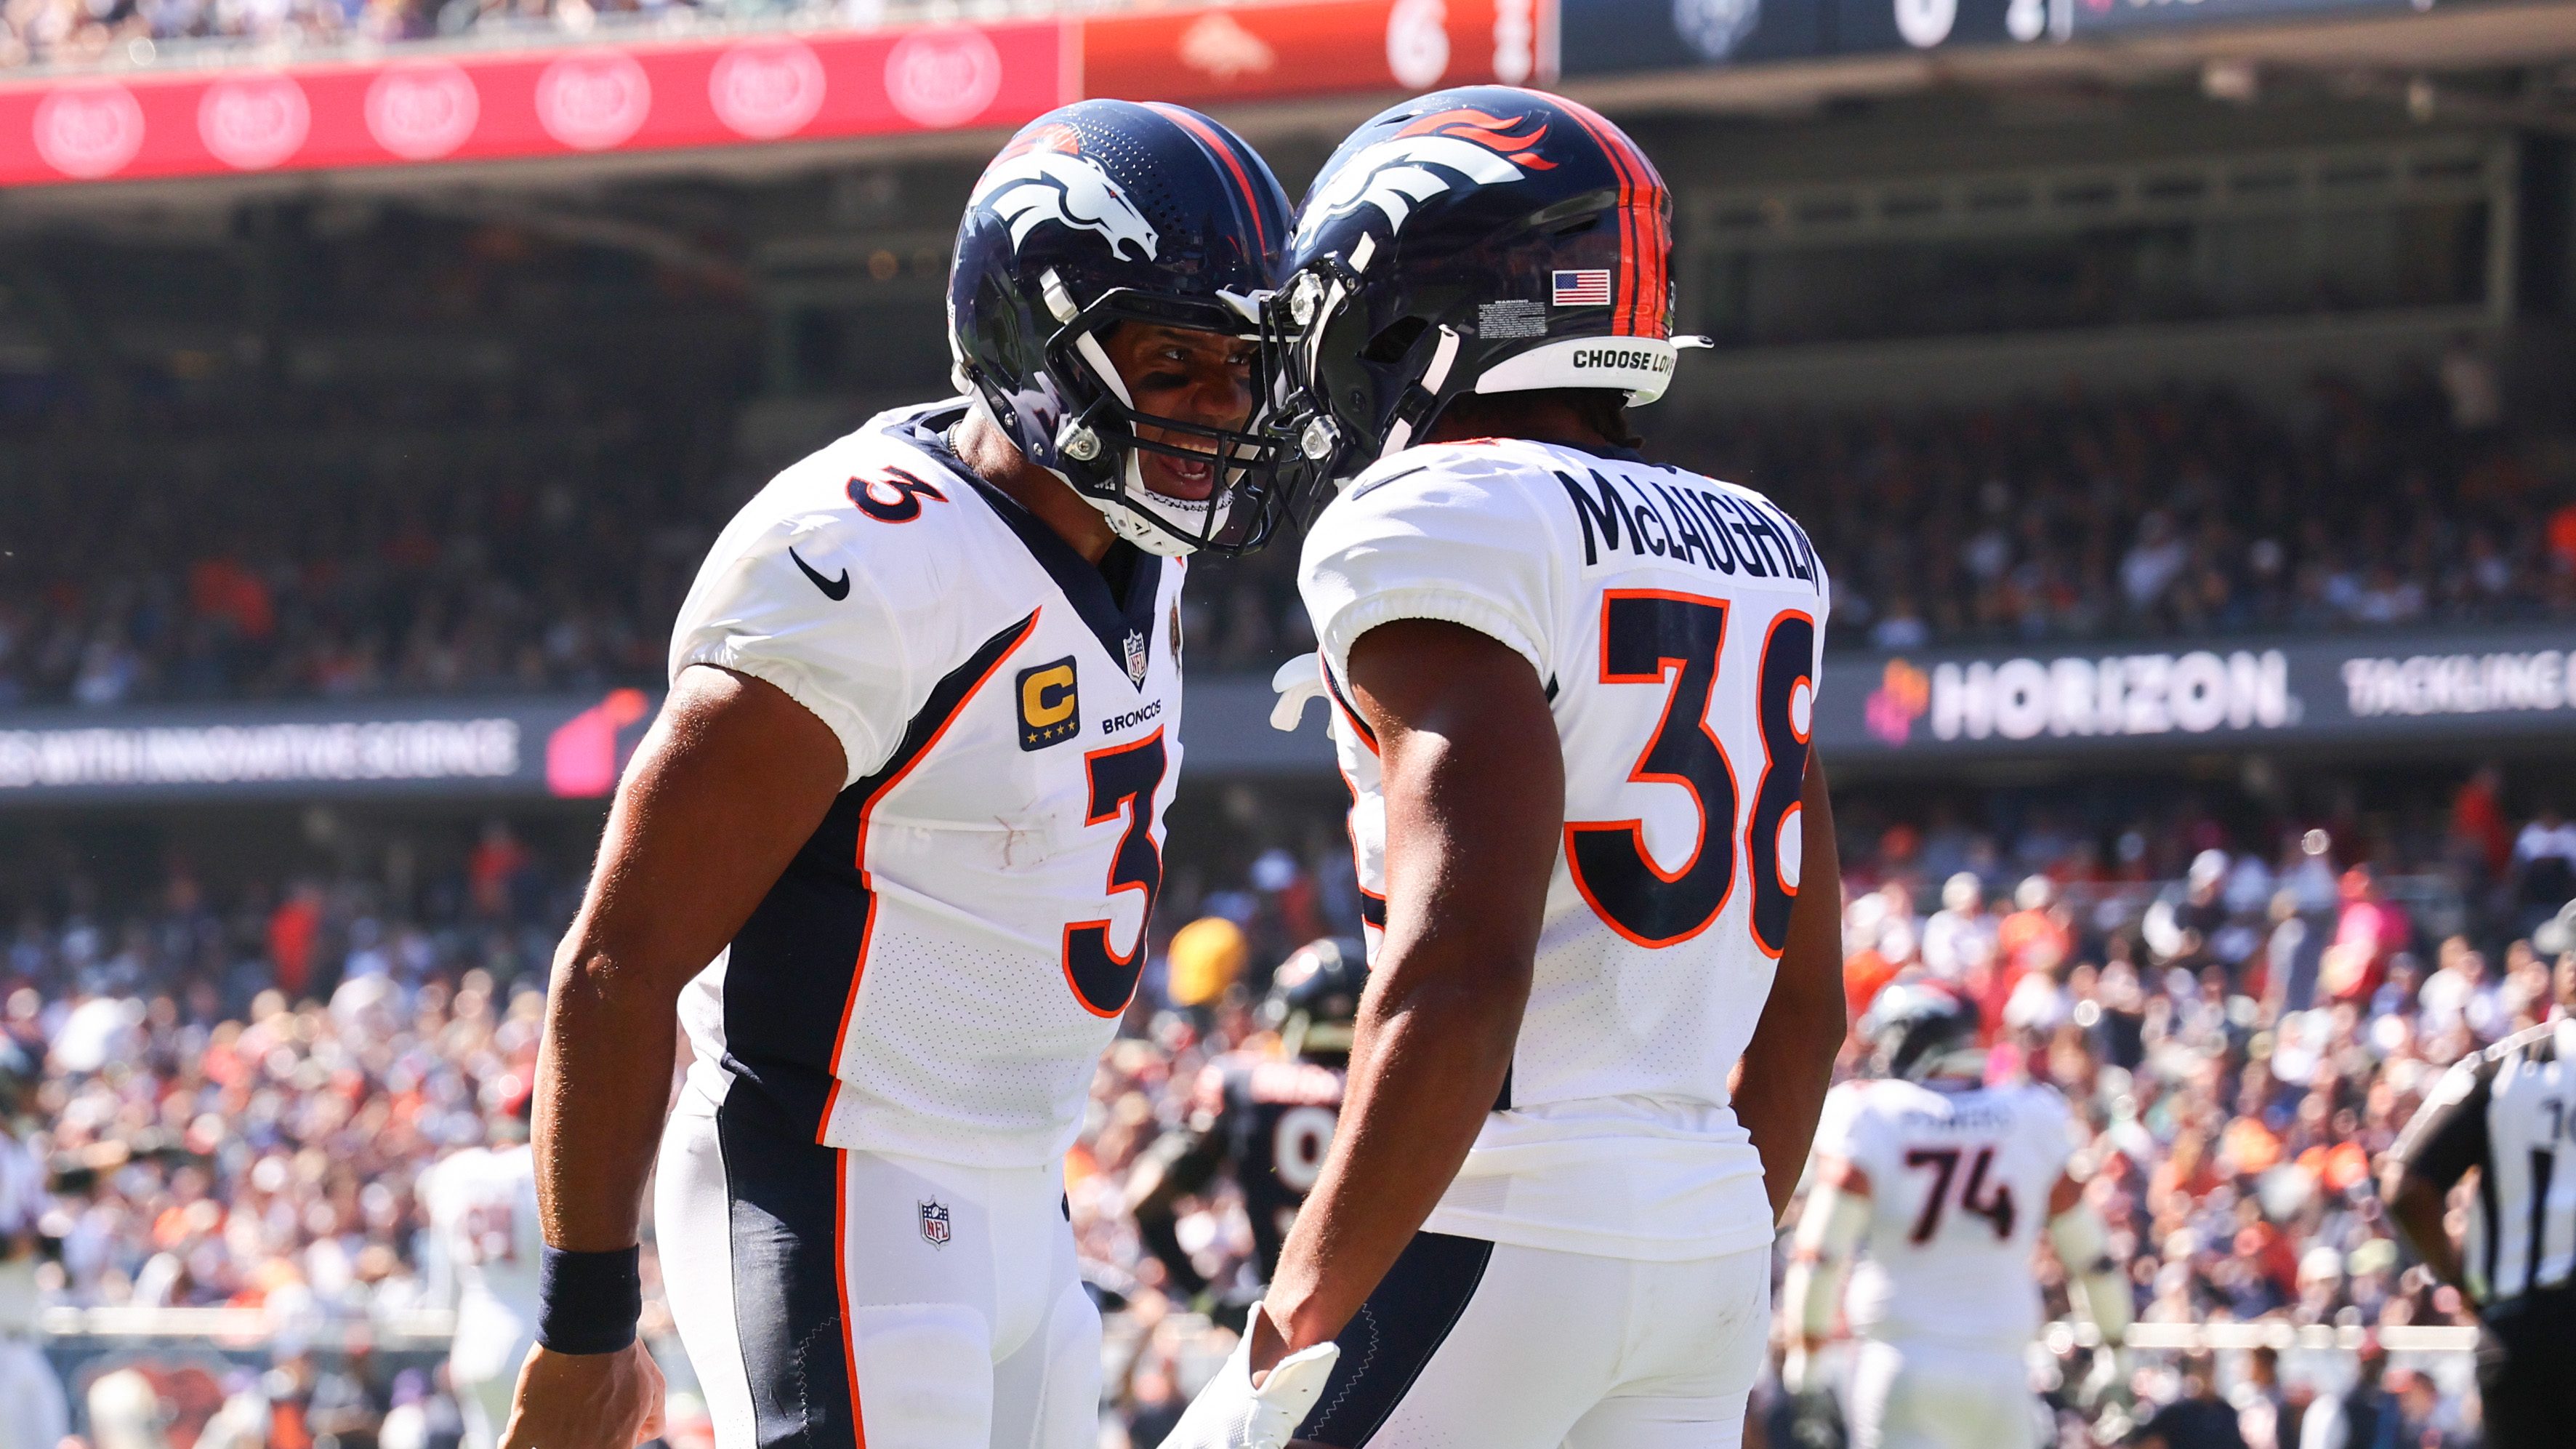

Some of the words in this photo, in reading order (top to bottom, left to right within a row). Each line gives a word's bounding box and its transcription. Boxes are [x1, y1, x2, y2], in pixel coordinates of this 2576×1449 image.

[1385, 0, 1451, 89] 6
[1573, 350, 1651, 370] CHOOSE
[845, 465, 949, 524] 3
[1022, 665, 1075, 728] C
[1130, 653, 1145, 675] NFL
[1931, 649, 2287, 741] HORIZON
[2341, 649, 2564, 717] TACKLING
[1102, 699, 1162, 735] BRONCOS
[1564, 589, 1814, 959] 38
[1062, 724, 1168, 1019] 3
[1904, 1144, 2018, 1246] 74
[926, 1219, 949, 1240] NFL
